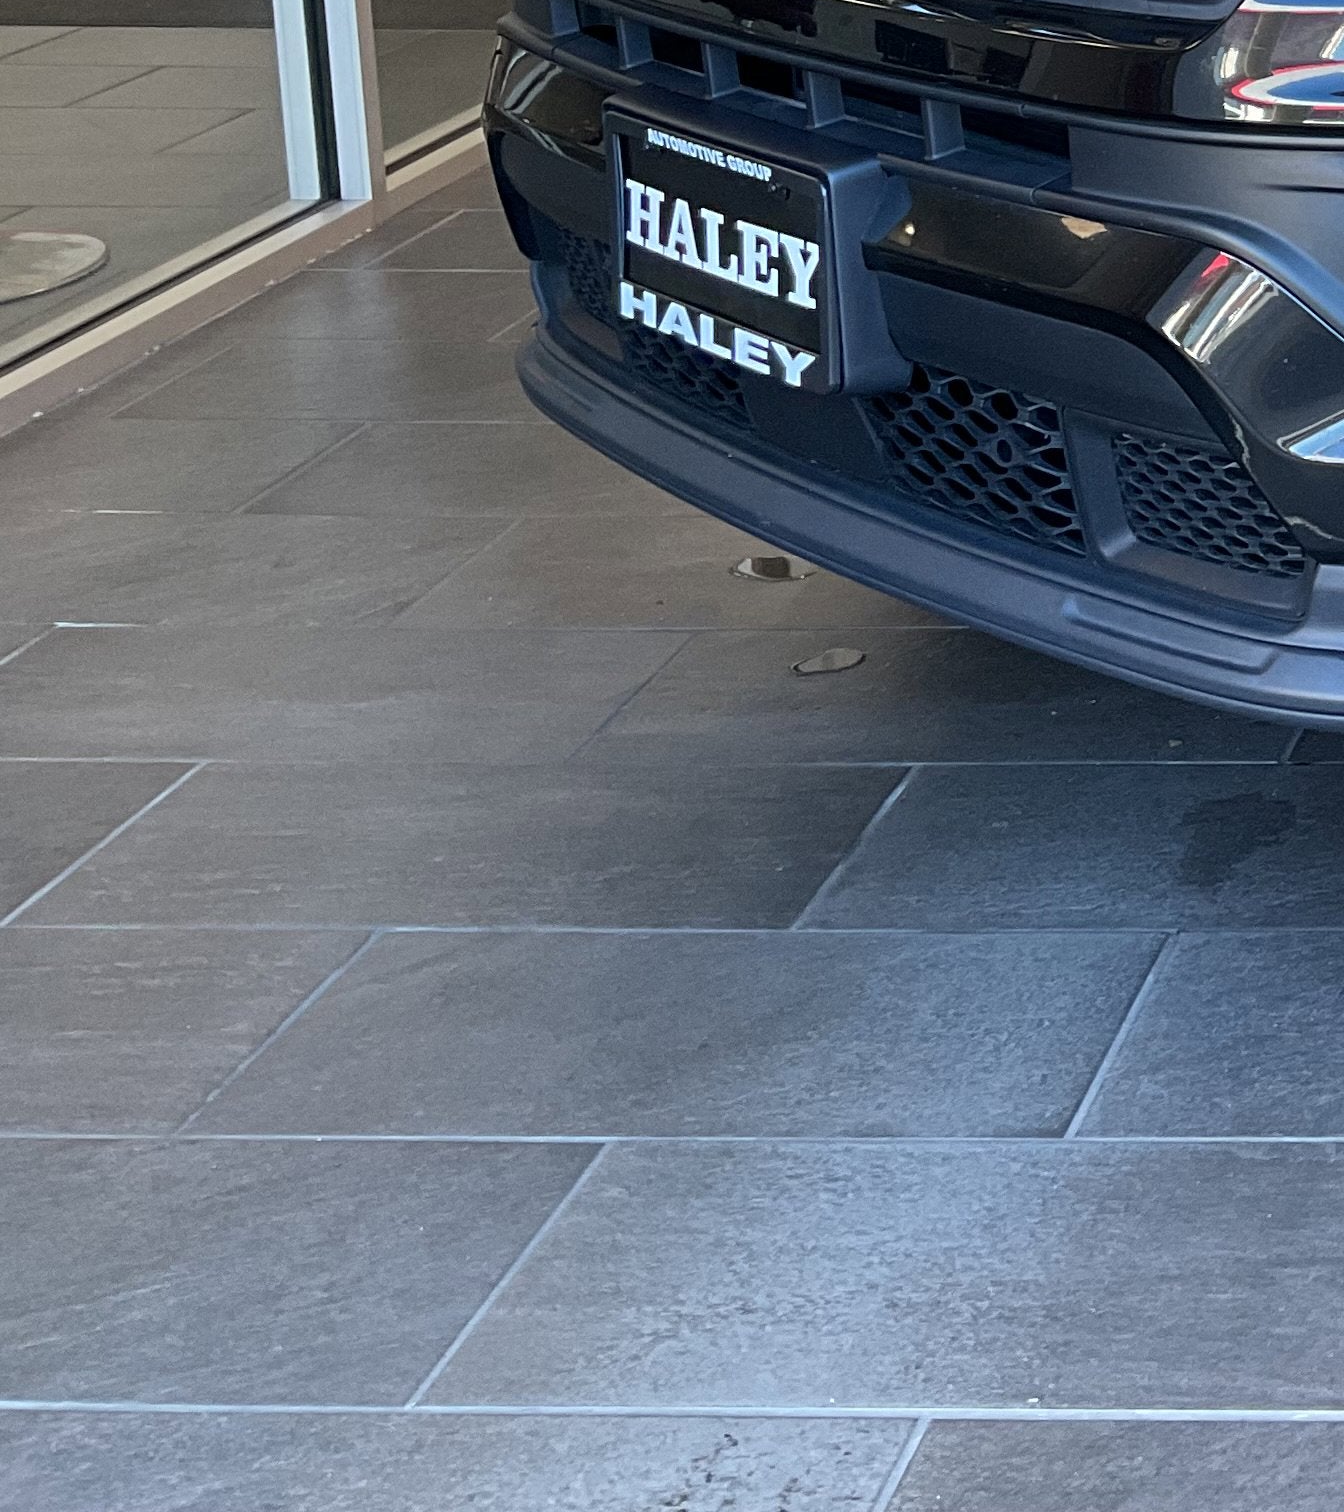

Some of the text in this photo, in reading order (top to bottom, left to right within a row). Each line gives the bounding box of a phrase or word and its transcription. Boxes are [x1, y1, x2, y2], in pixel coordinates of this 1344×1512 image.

[647, 128, 773, 182] AUTOMOTIVE GROUP
[625, 178, 820, 310] HALEY
[620, 281, 816, 387] HALEY
